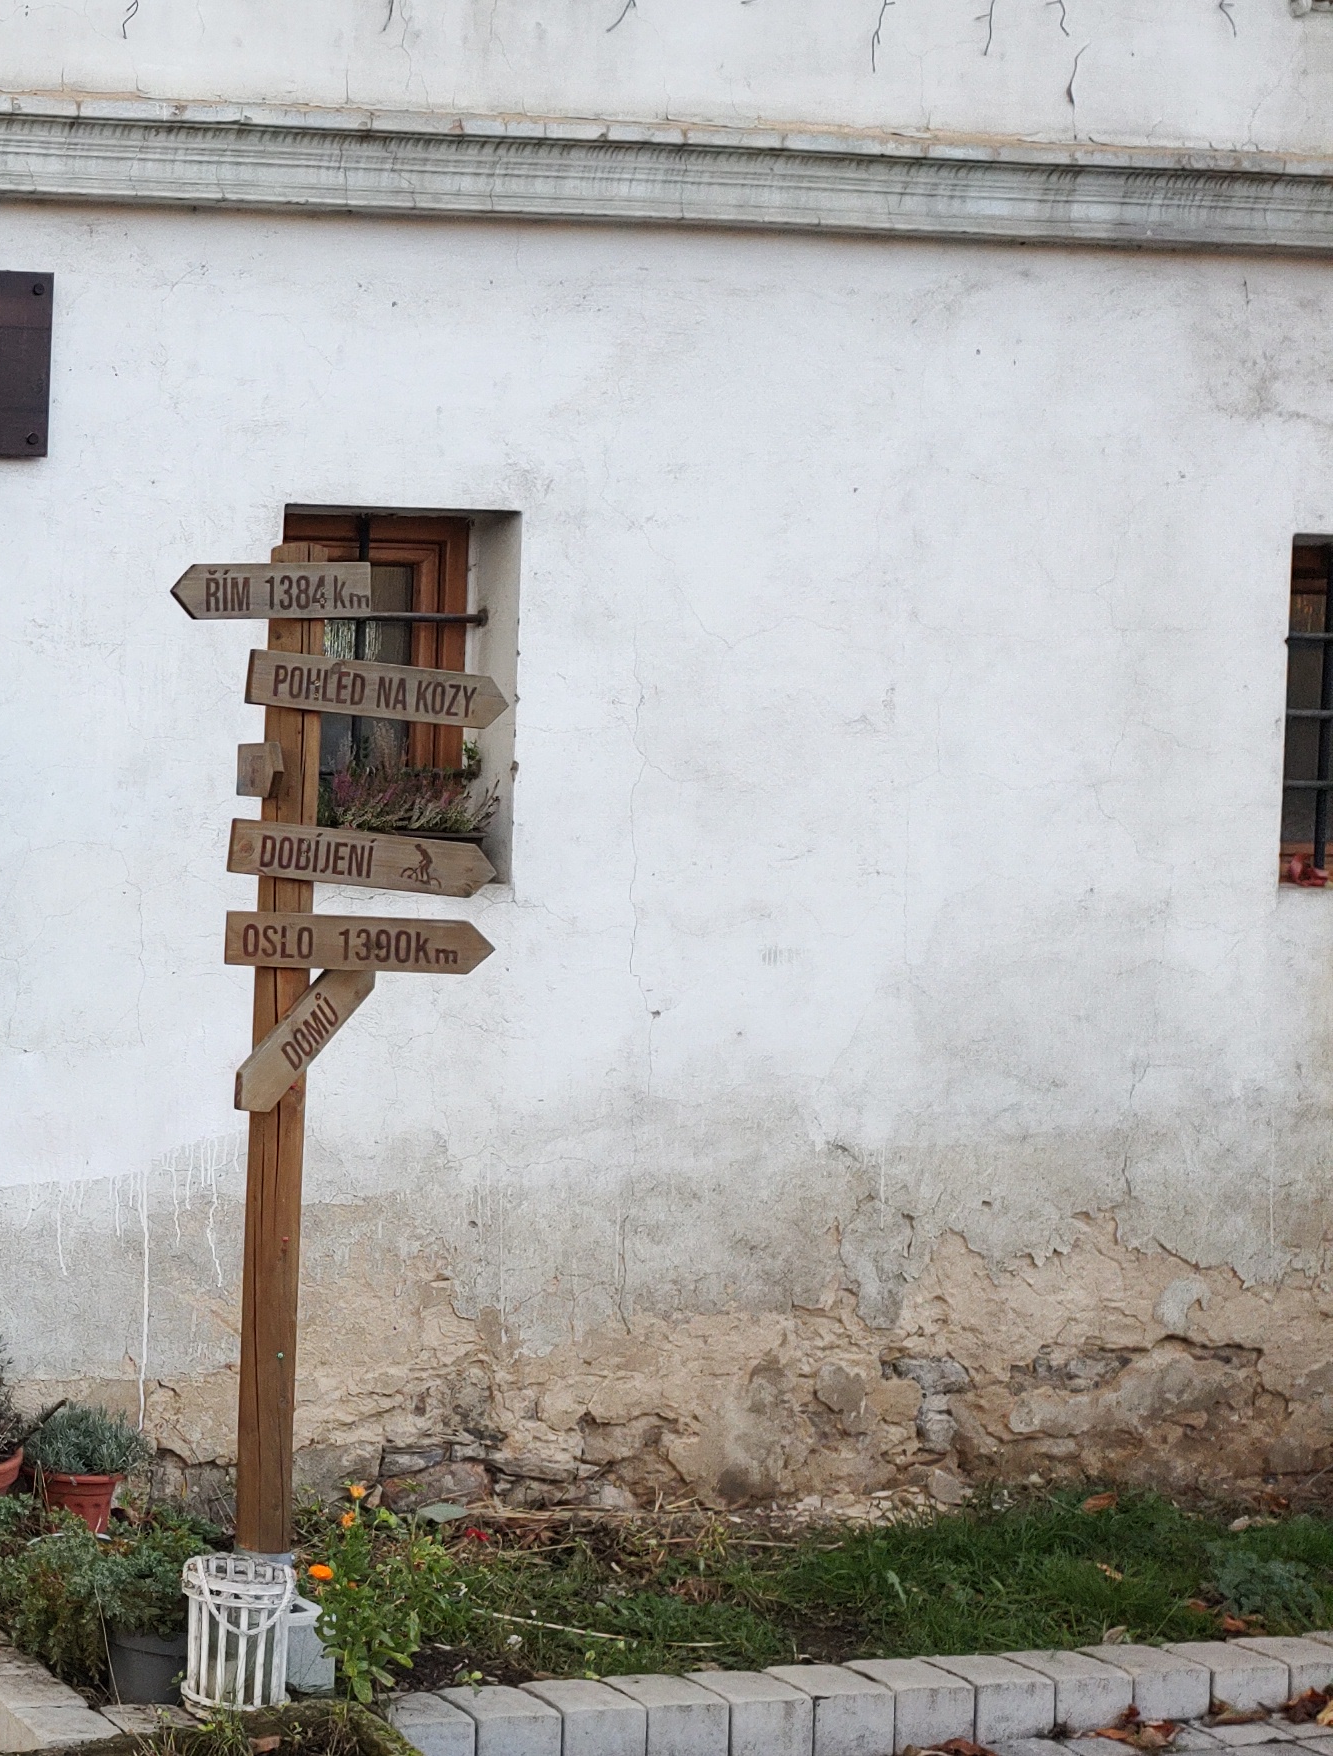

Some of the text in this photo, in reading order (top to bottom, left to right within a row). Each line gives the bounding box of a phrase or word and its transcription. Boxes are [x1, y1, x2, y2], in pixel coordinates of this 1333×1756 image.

[205, 569, 251, 612] ŘÍM
[272, 664, 478, 719] POHLED NA KOZY
[259, 832, 377, 879] DOBÍJENÍ
[242, 923, 314, 959] OSLO
[281, 992, 339, 1072] DOMŮ
